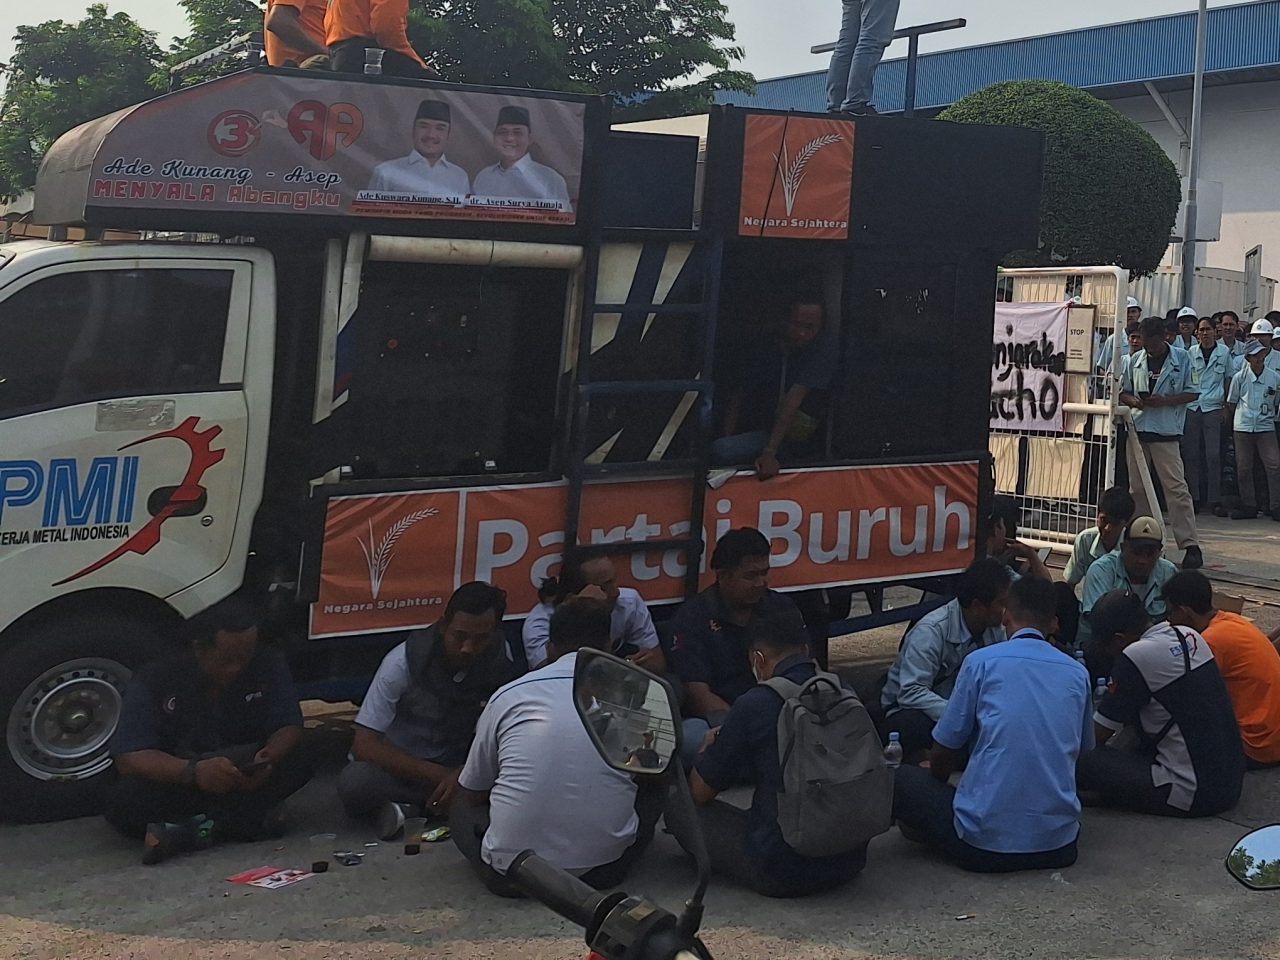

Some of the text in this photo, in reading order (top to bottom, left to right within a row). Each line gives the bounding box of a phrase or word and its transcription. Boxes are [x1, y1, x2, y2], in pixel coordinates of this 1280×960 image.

[223, 116, 249, 148] 3
[103, 157, 153, 176] Ade
[162, 159, 253, 185] Kunang
[284, 166, 342, 190] Asep
[92, 179, 342, 210] MENYALA Abangku
[744, 217, 847, 229] Negara Sejahtera
[1070, 328, 1084, 336] STOP
[0, 525, 130, 545] ERJA METAL INDONESIA
[757, 486, 971, 567] Buruh
[324, 597, 443, 614] Negara Sejahtera
